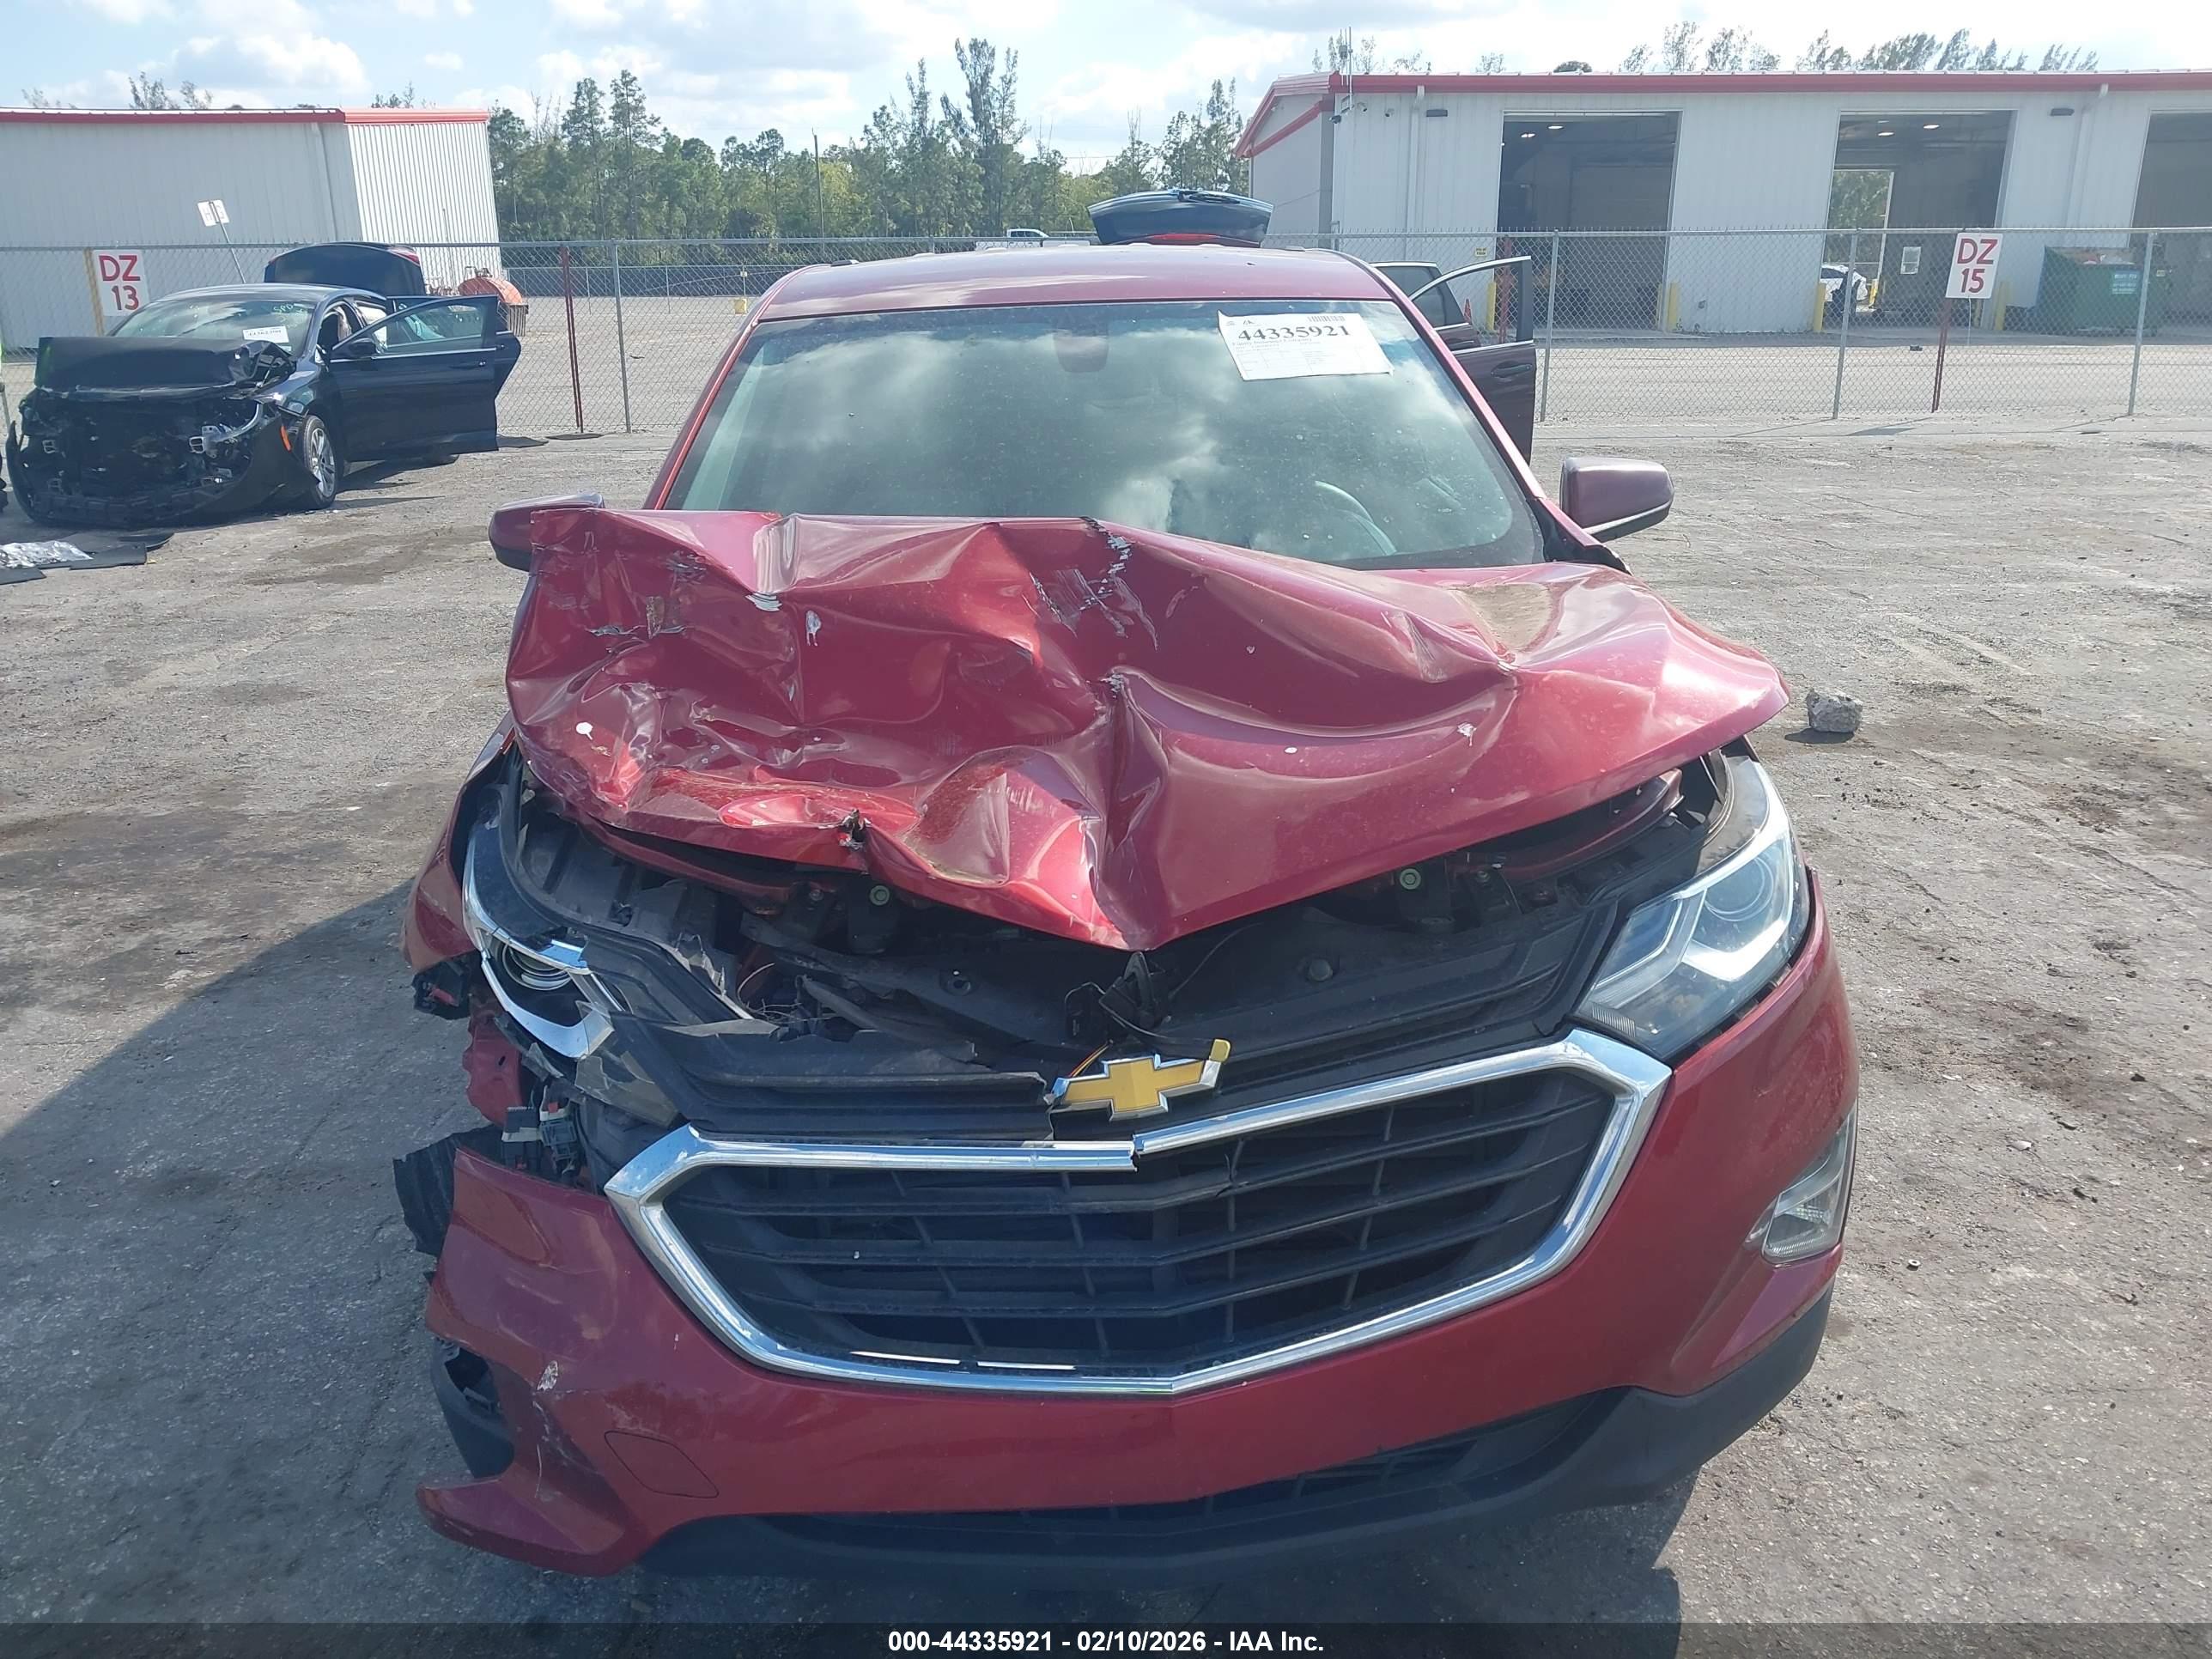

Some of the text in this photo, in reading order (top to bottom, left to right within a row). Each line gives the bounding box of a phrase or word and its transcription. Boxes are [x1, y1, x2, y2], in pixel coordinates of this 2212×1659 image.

[1957, 238, 1998, 264] DZ
[98, 255, 141, 282] DZ
[1960, 268, 1985, 294] 15
[111, 285, 139, 311] 13
[1238, 325, 1350, 341] 44335921
